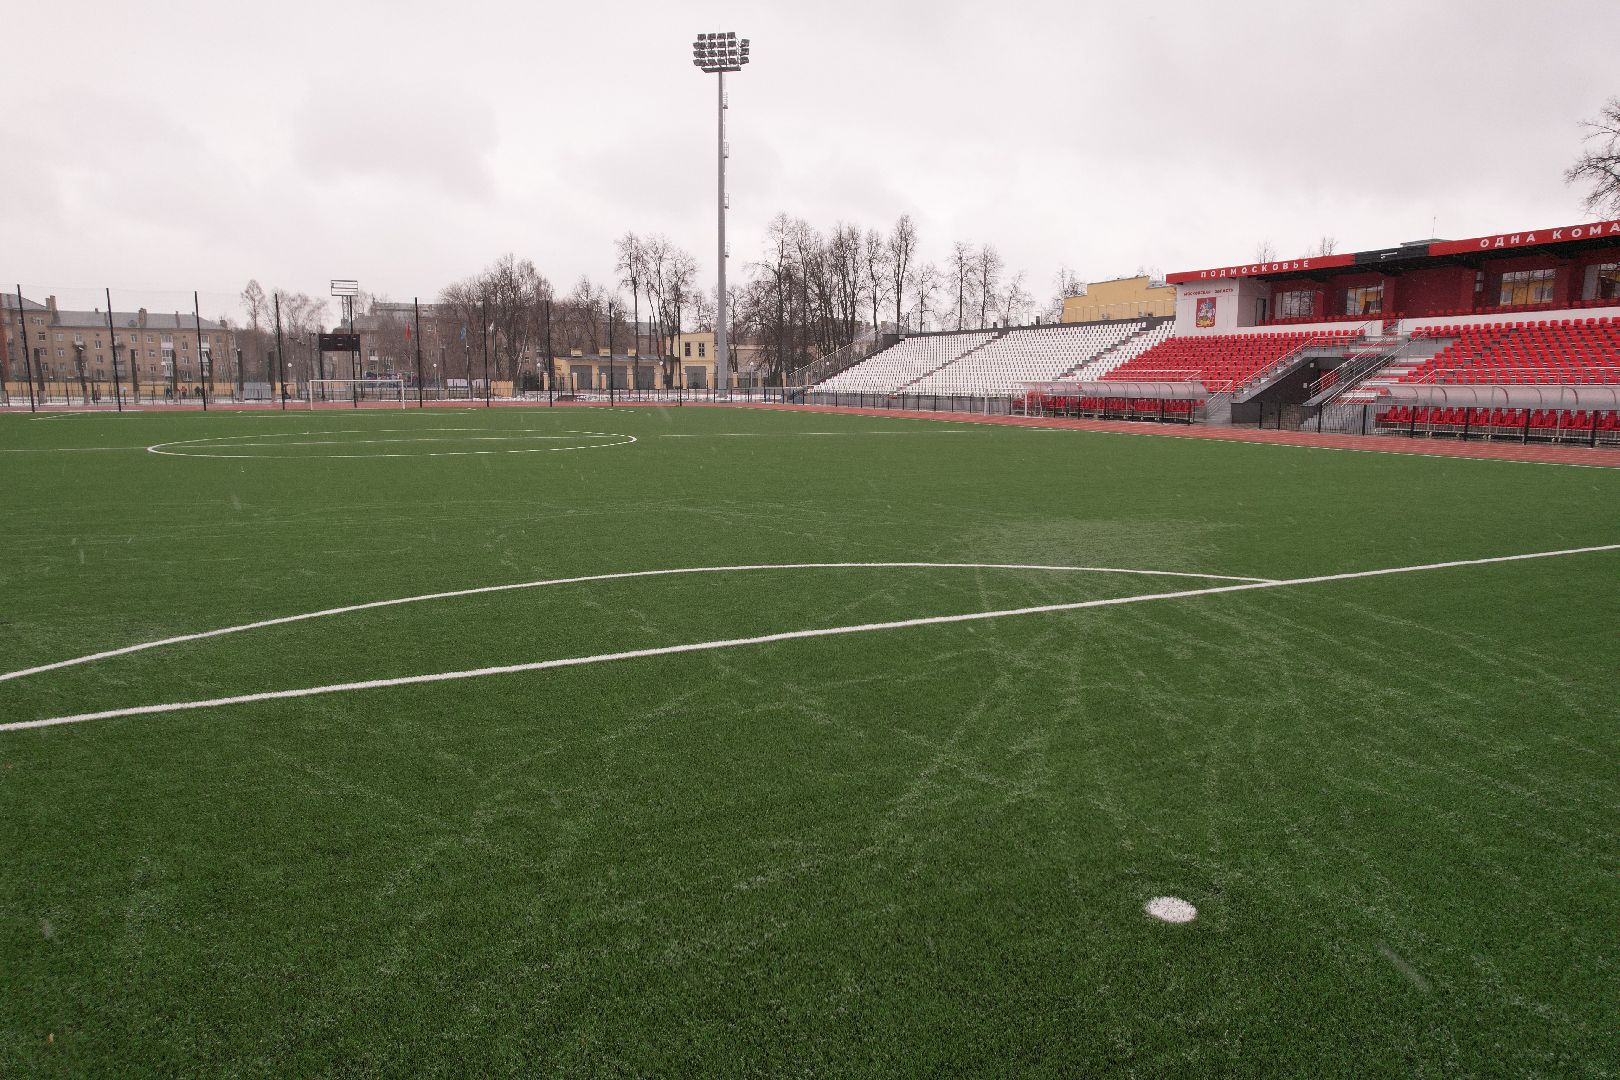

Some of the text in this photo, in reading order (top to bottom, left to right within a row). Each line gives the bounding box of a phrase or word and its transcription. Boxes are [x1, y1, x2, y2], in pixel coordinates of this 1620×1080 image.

[1480, 222, 1620, 248] ОДНА КОМА
[1200, 259, 1310, 278] ПОДМОСКОВЬЕ
